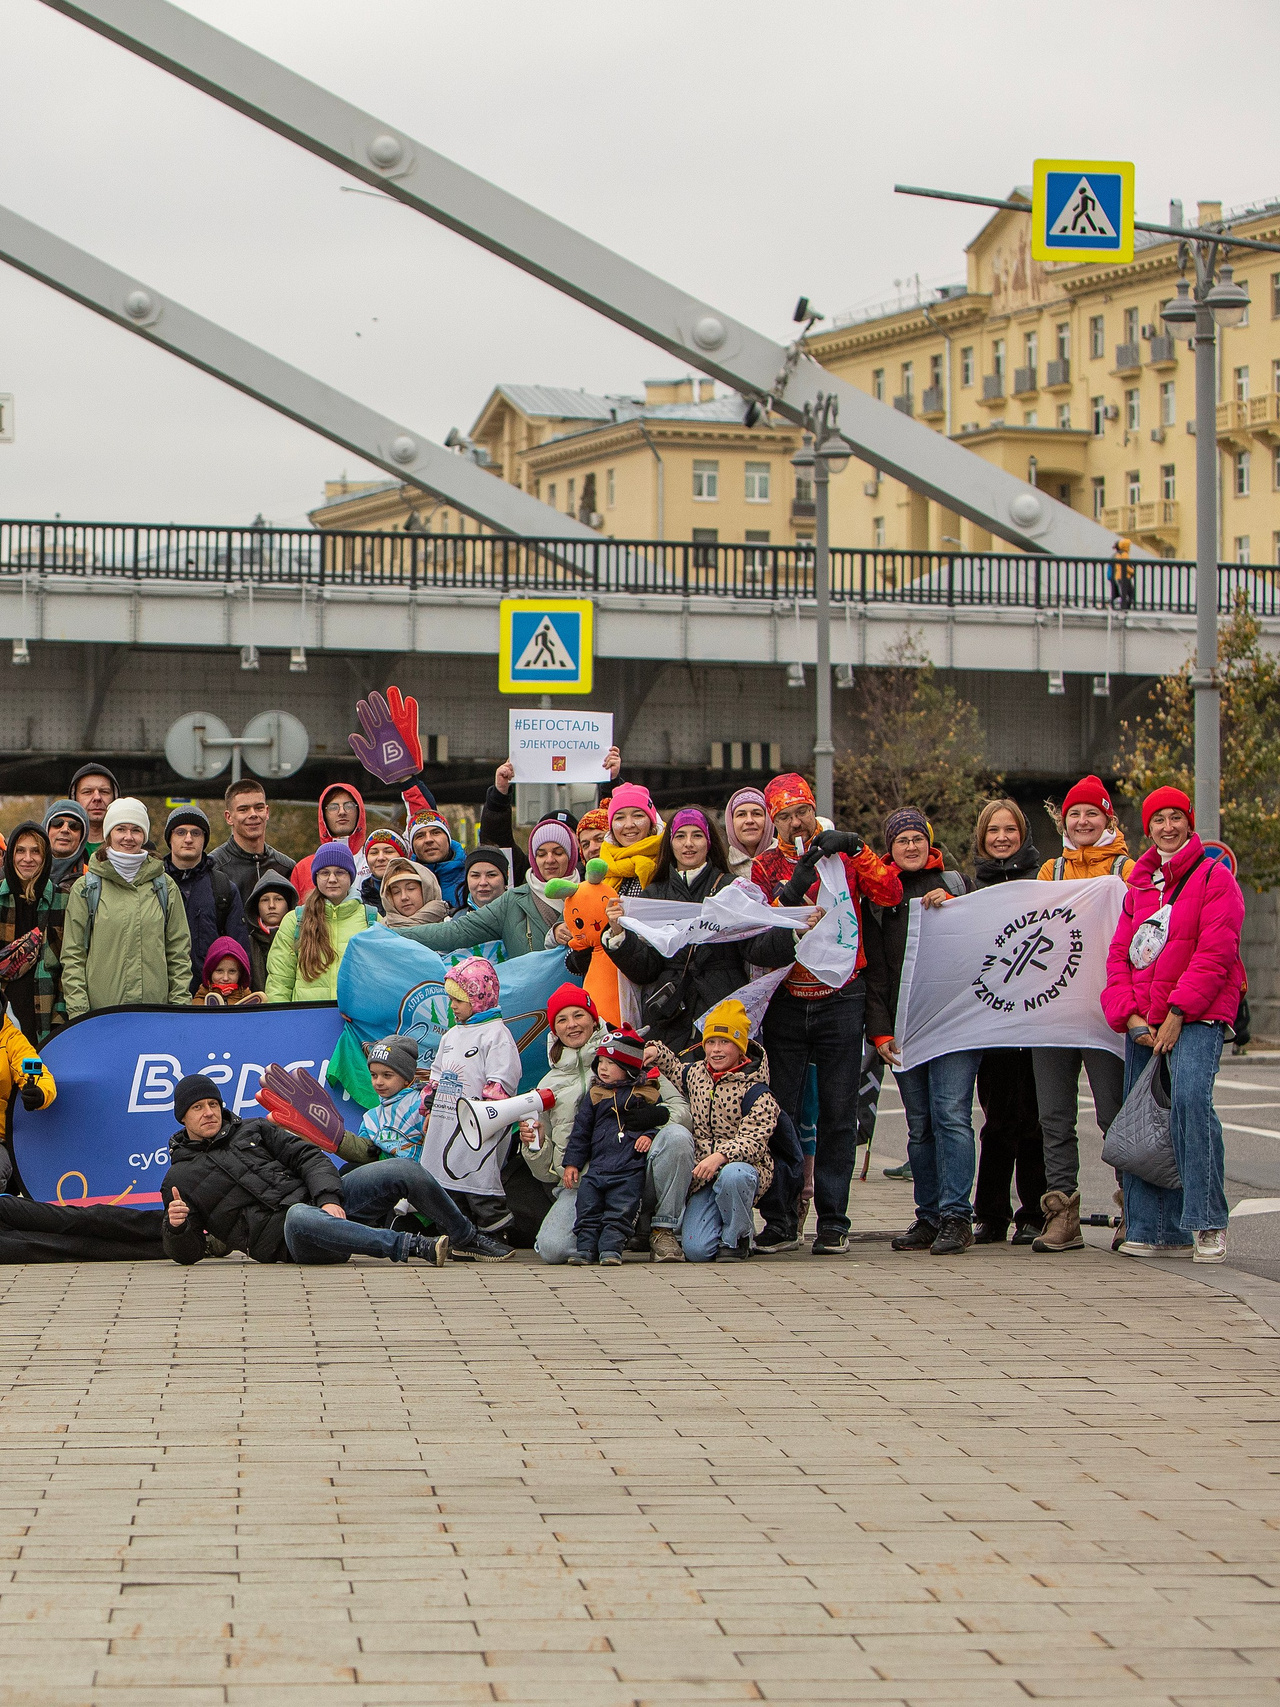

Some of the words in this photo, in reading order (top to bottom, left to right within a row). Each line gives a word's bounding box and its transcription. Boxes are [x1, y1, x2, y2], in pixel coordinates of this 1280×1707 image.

[514, 718, 600, 732] #БЕГОСТАЛЬ
[519, 739, 600, 750] ЭЛЕКТРОСТАЛЬ
[371, 1049, 391, 1061] STAR
[128, 1146, 172, 1171] суб
